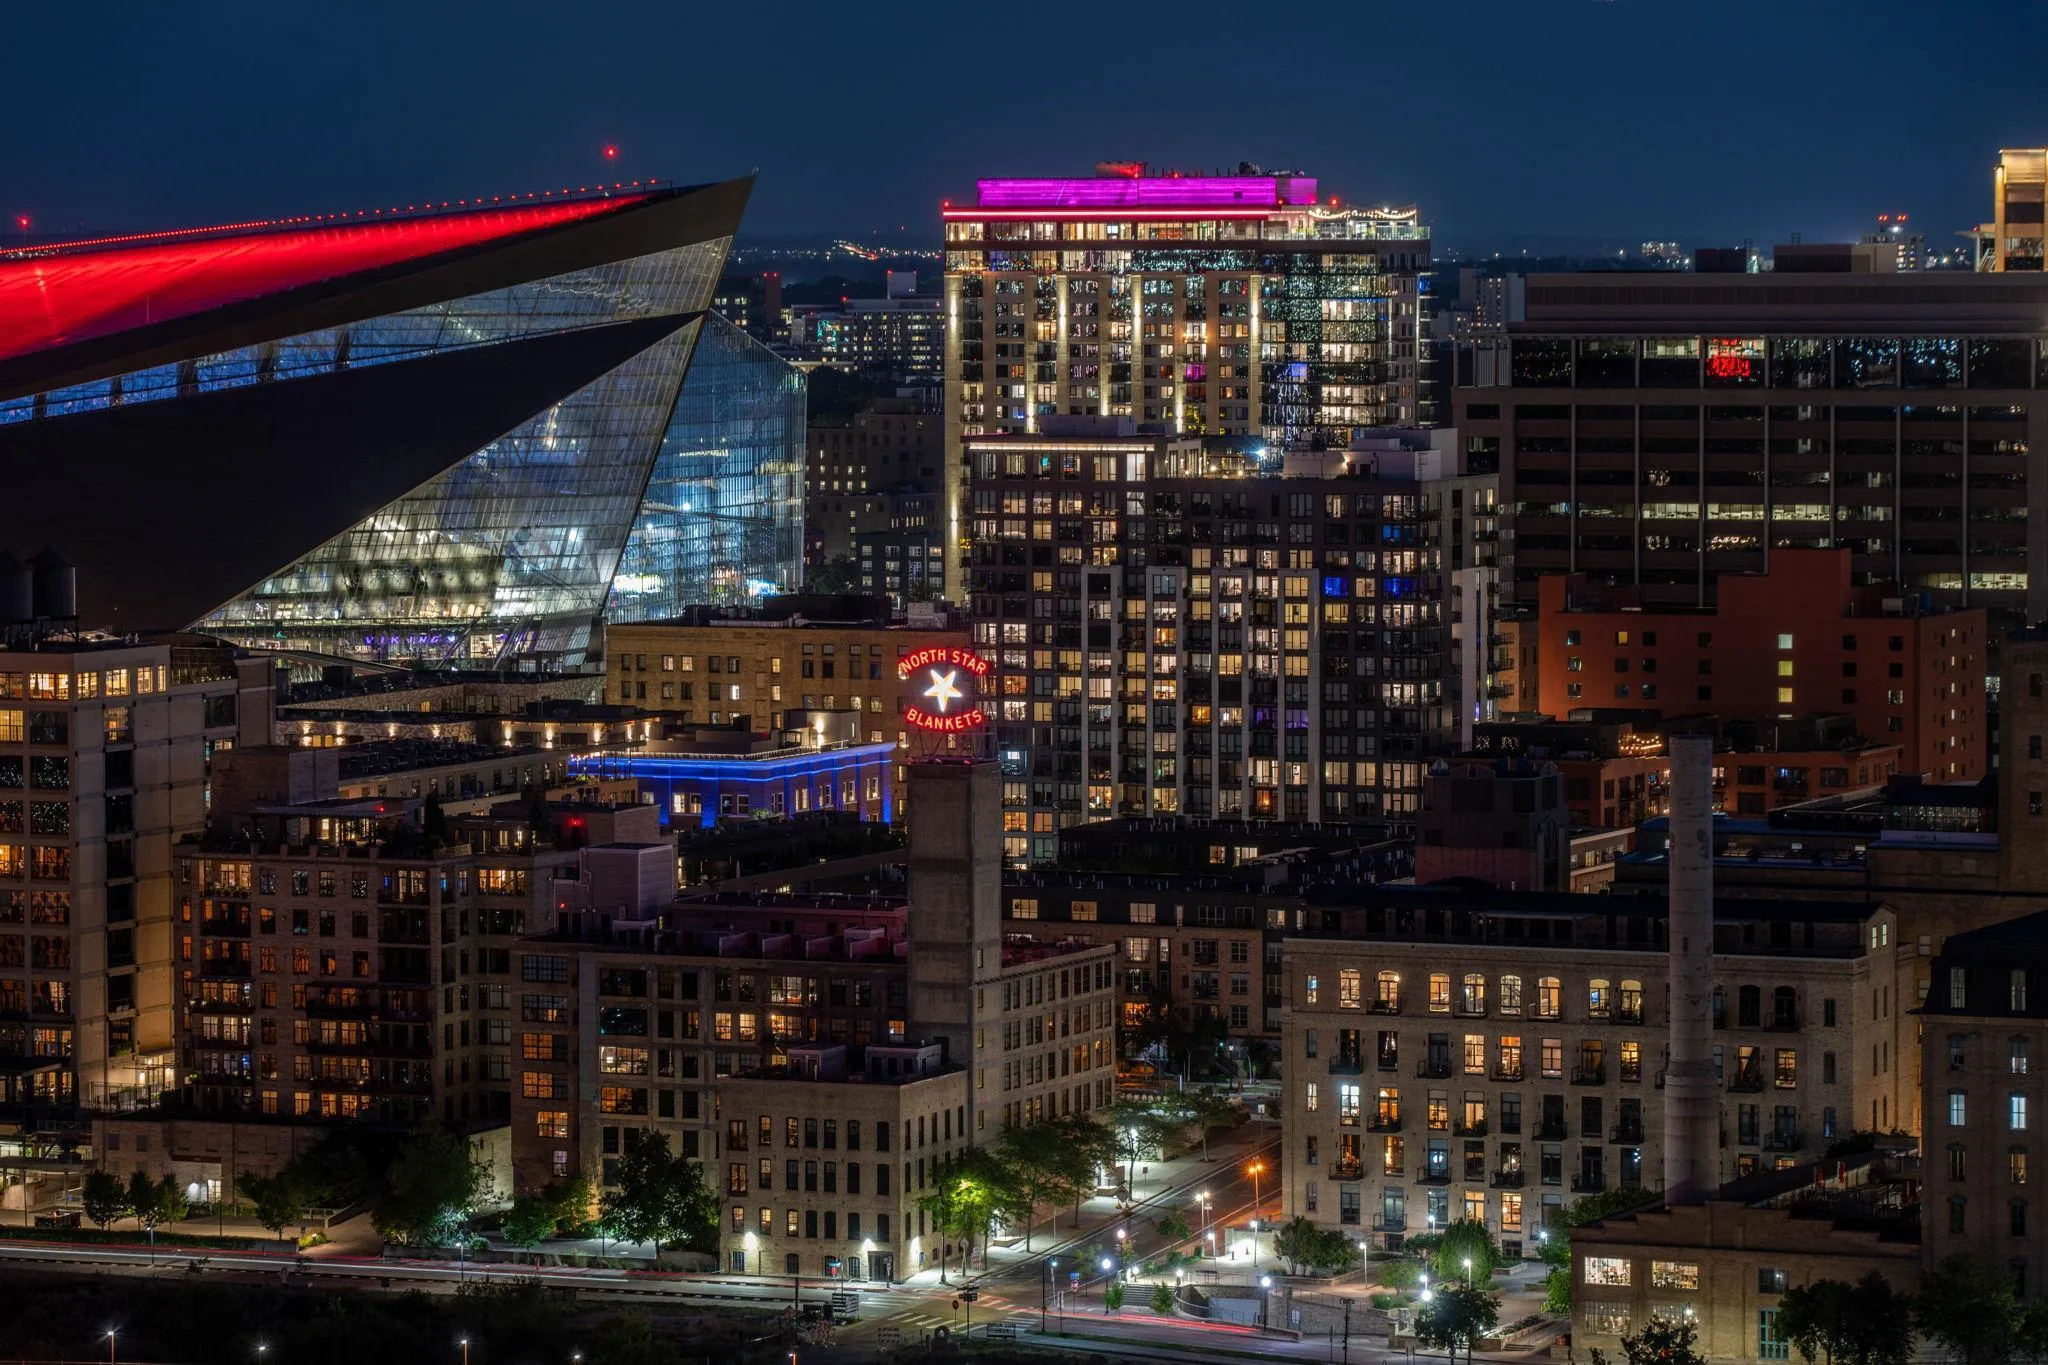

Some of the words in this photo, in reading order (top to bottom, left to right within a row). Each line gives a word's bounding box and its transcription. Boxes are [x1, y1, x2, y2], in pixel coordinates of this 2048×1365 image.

[899, 649, 946, 673] NORTH
[952, 650, 987, 674] STAR
[906, 708, 982, 730] BLANKETS
